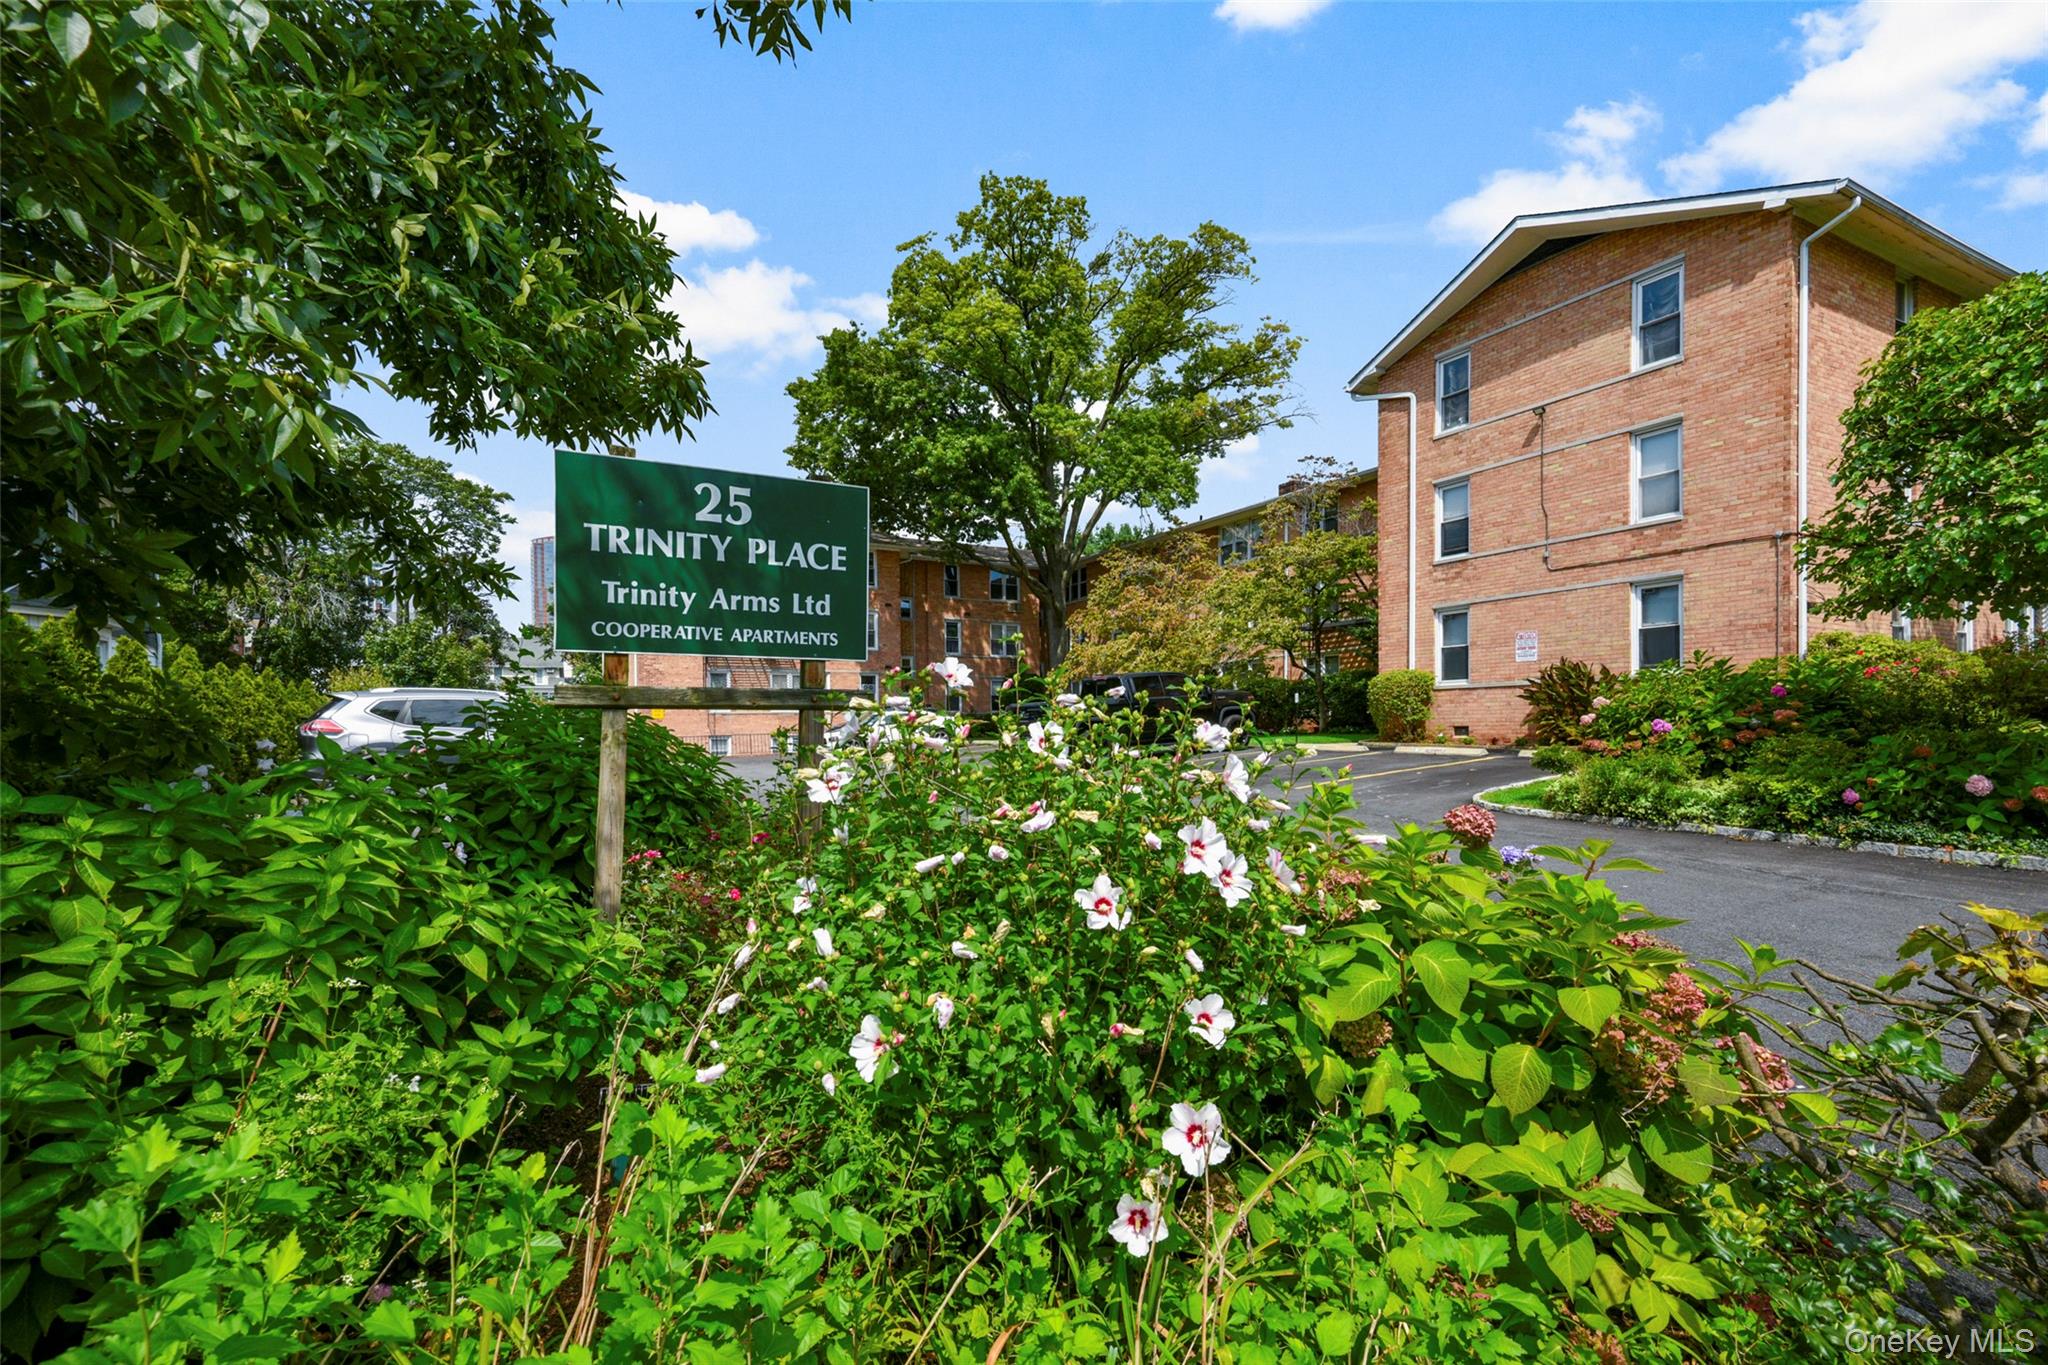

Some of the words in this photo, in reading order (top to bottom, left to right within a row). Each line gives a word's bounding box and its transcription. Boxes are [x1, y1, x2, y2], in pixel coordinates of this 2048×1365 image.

[694, 482, 753, 526] 25
[583, 522, 732, 562] TRINITY
[748, 537, 848, 572] PLACE
[601, 580, 697, 615] Trinity
[708, 588, 780, 614] Arms
[792, 593, 831, 617] Ltd
[591, 621, 723, 642] COOPERATIVE
[730, 628, 839, 647] APARTMENTS
